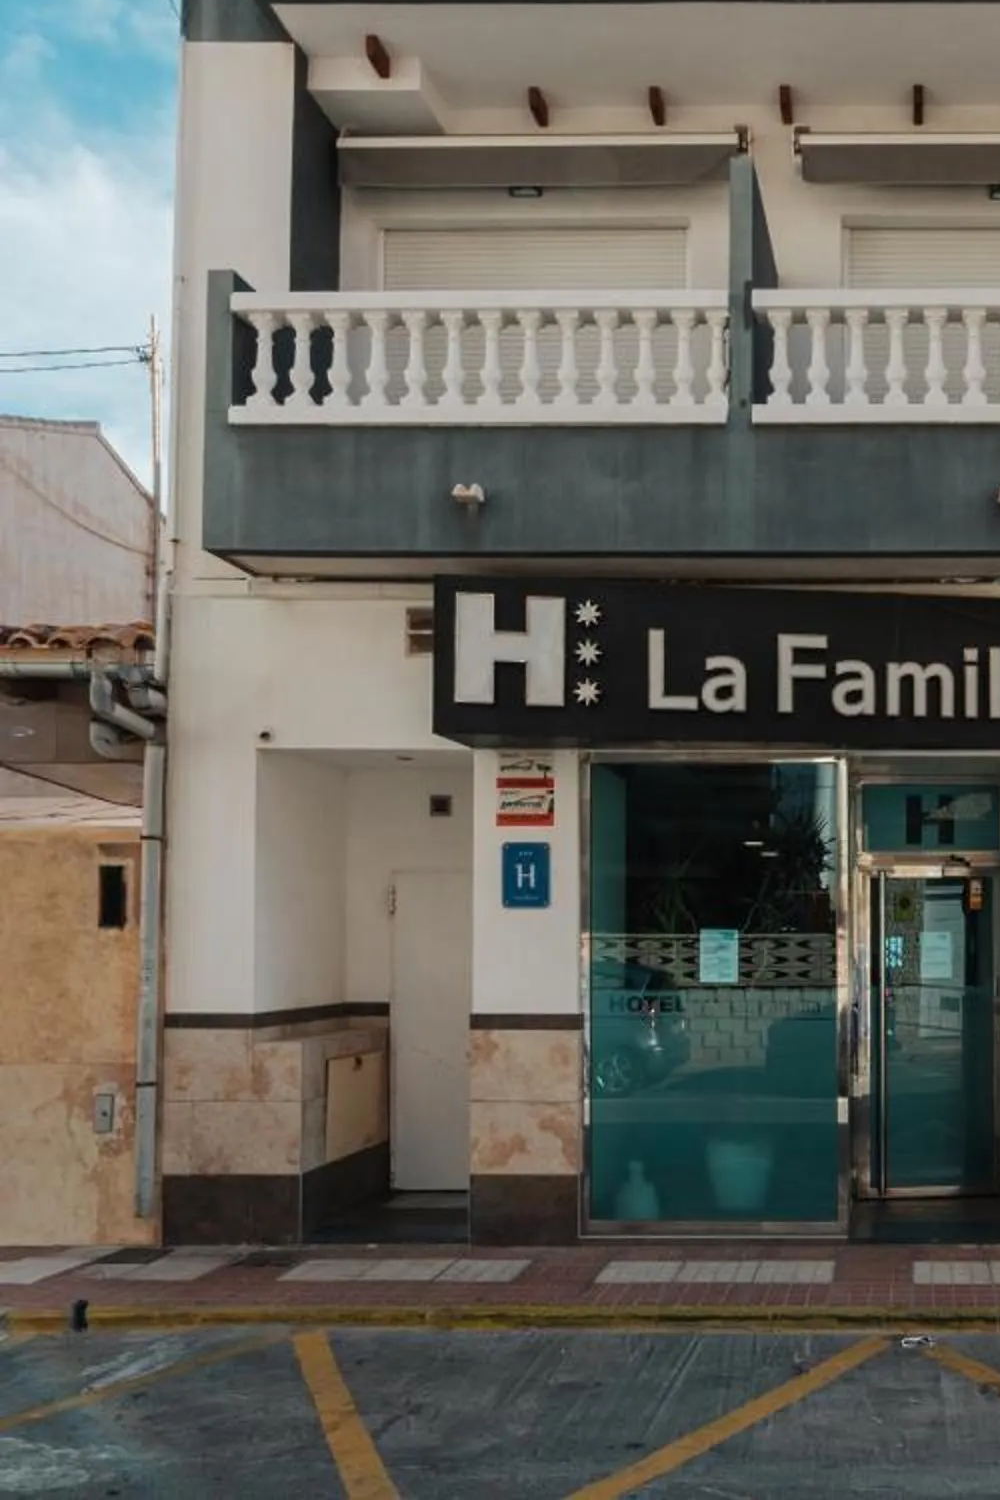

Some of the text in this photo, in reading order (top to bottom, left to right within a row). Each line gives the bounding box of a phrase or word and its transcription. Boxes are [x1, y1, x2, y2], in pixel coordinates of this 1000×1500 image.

[454, 591, 566, 708] H
[646, 628, 748, 714] La
[905, 794, 955, 845] H
[609, 994, 686, 1013] HOTEL
